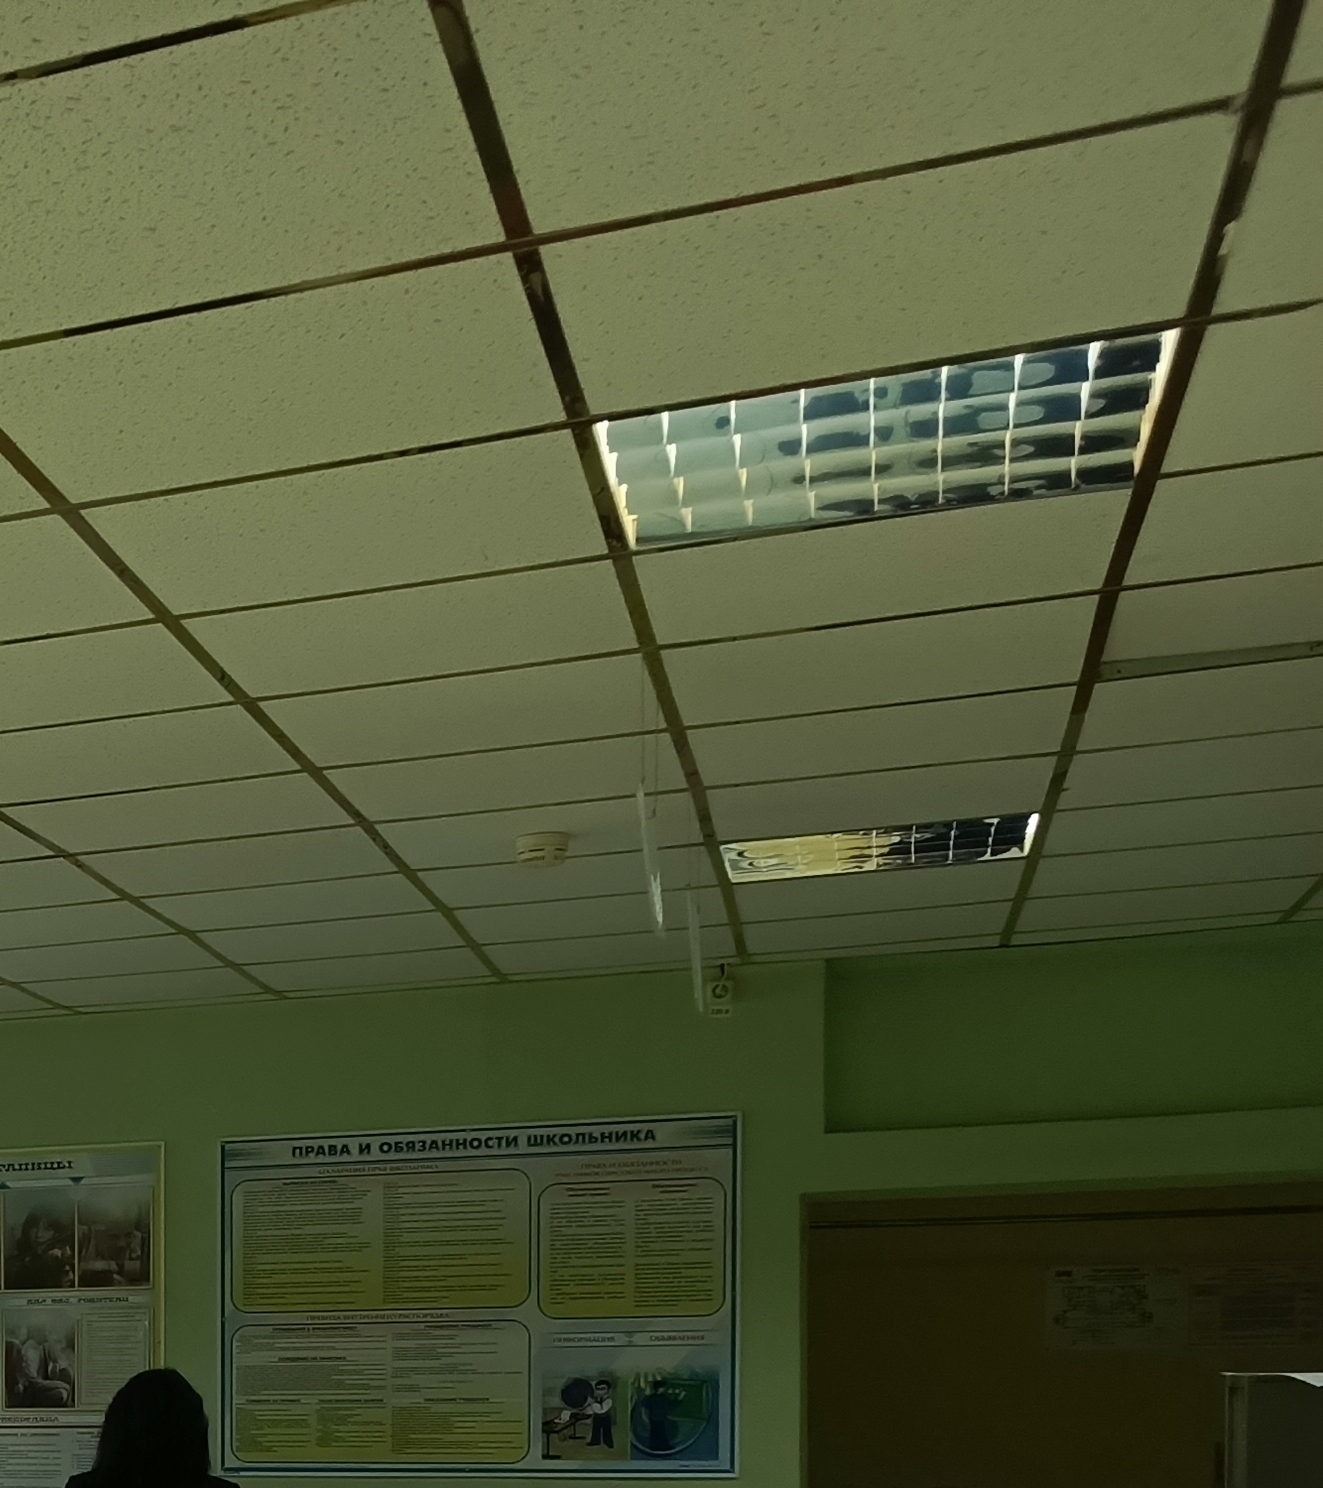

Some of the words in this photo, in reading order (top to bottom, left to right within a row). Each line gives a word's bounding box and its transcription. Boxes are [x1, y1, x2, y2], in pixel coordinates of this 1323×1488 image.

[291, 1143, 351, 1160] ПРАВА
[358, 1142, 371, 1156] И
[379, 1136, 519, 1155] ОБЯЗАННОСТИ
[527, 1128, 657, 1148] ШКОЛЬНИКА
